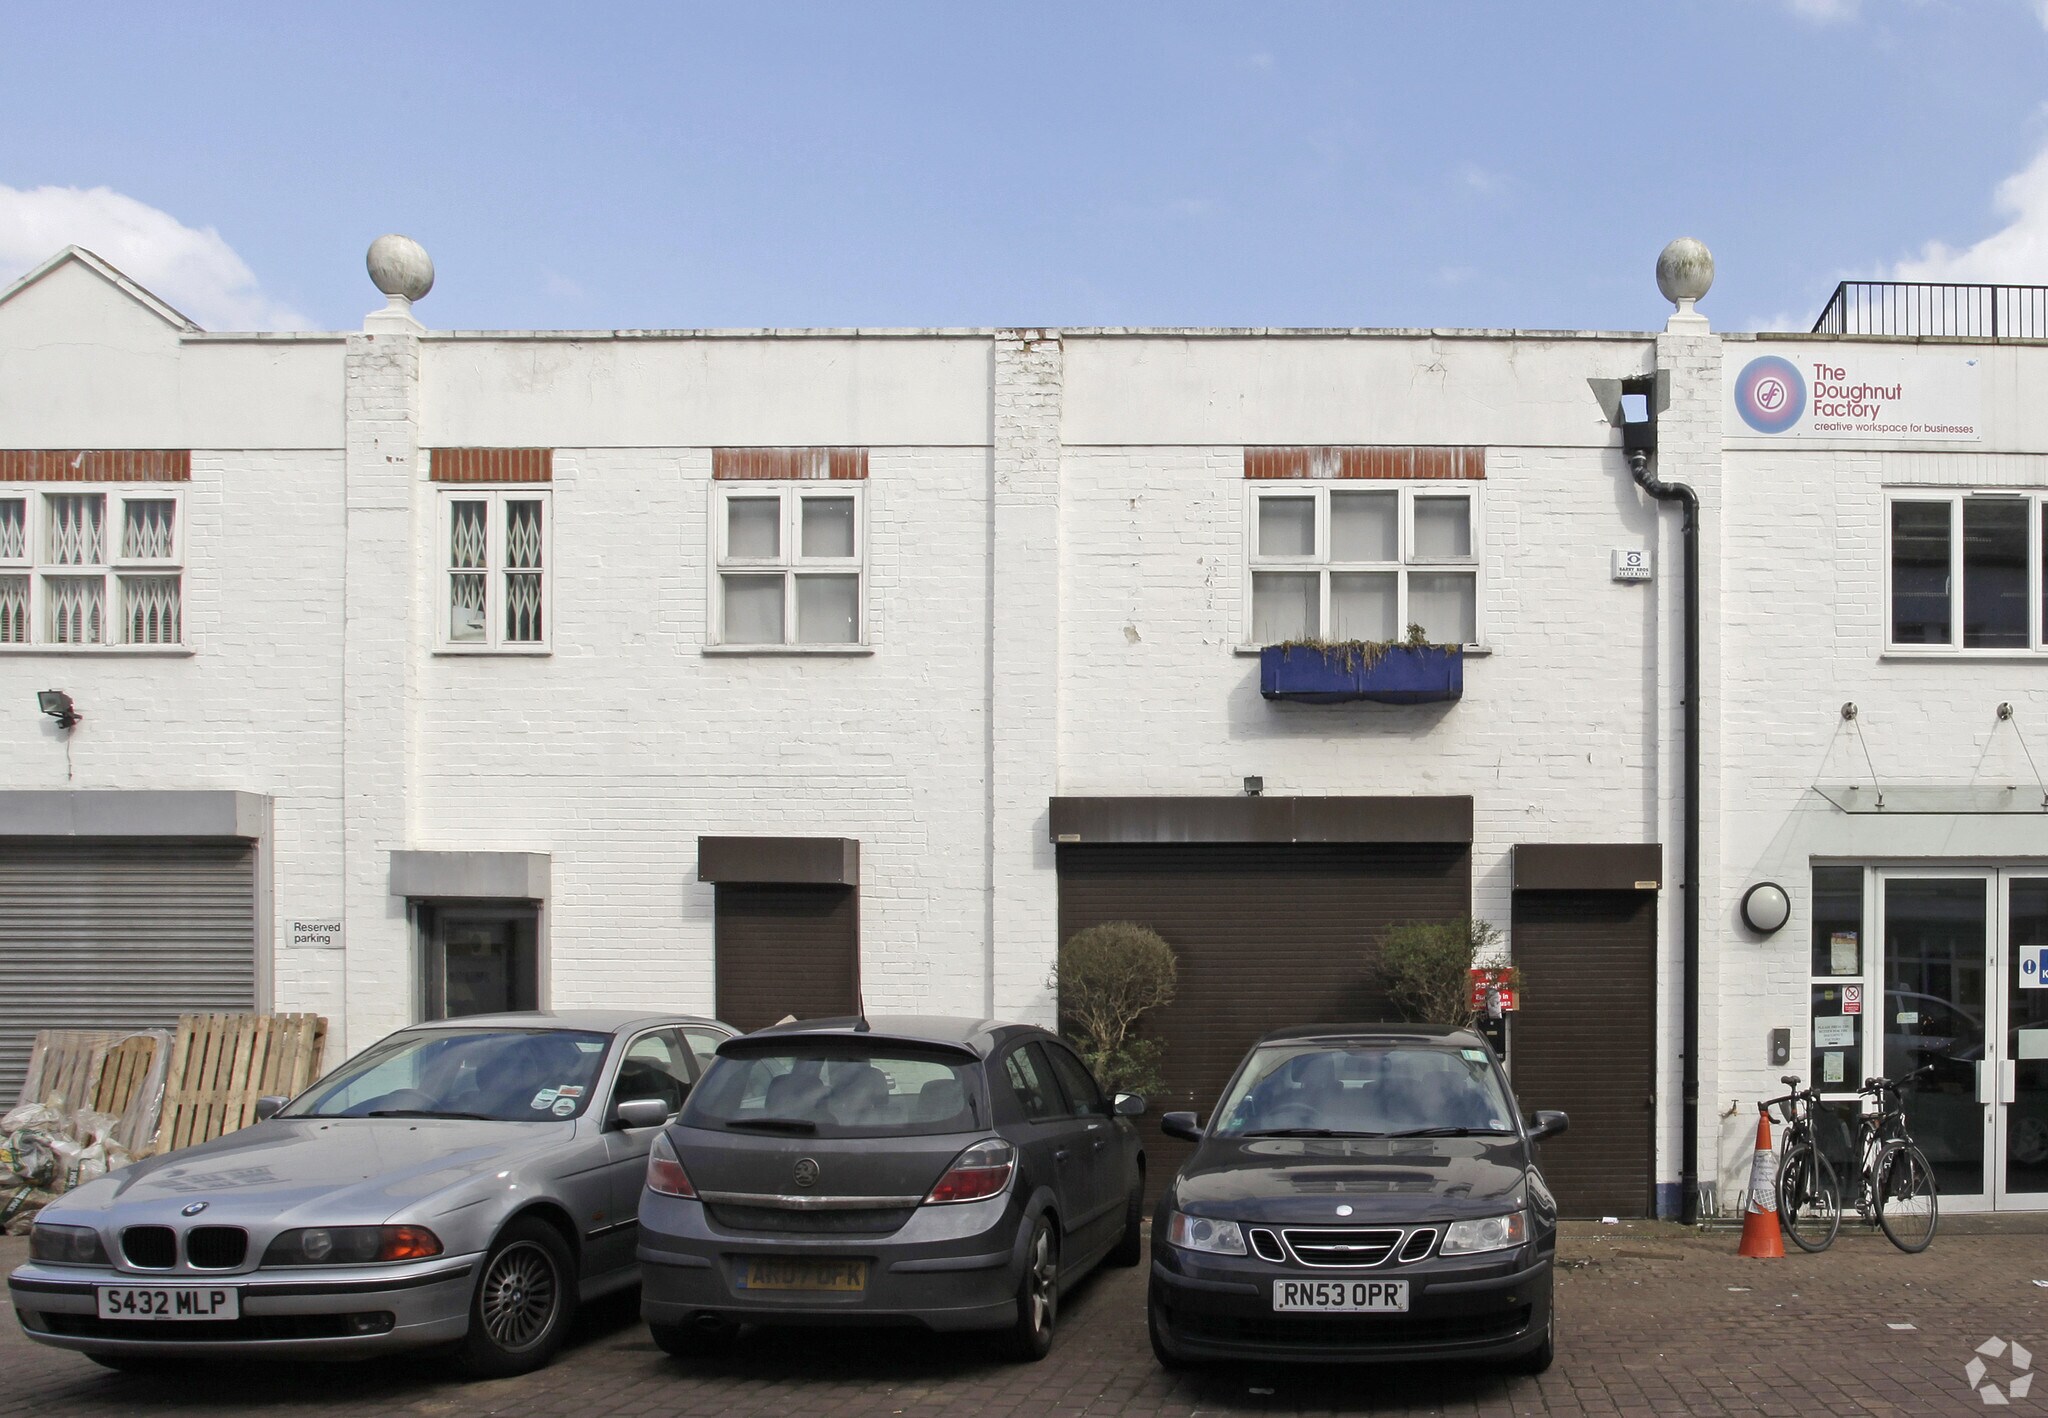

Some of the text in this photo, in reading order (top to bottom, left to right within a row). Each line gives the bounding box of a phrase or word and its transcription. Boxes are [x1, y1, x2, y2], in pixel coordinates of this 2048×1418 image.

[1813, 363, 1847, 381] The
[1813, 382, 1903, 403] Doughnut
[1813, 400, 1881, 421] Factory
[1814, 421, 1974, 435] creative workspace for businesses
[294, 922, 341, 932] Reserved
[294, 933, 331, 945] parking
[108, 1290, 226, 1315] S432 MLP
[1284, 1283, 1398, 1306] RN53 OPR
